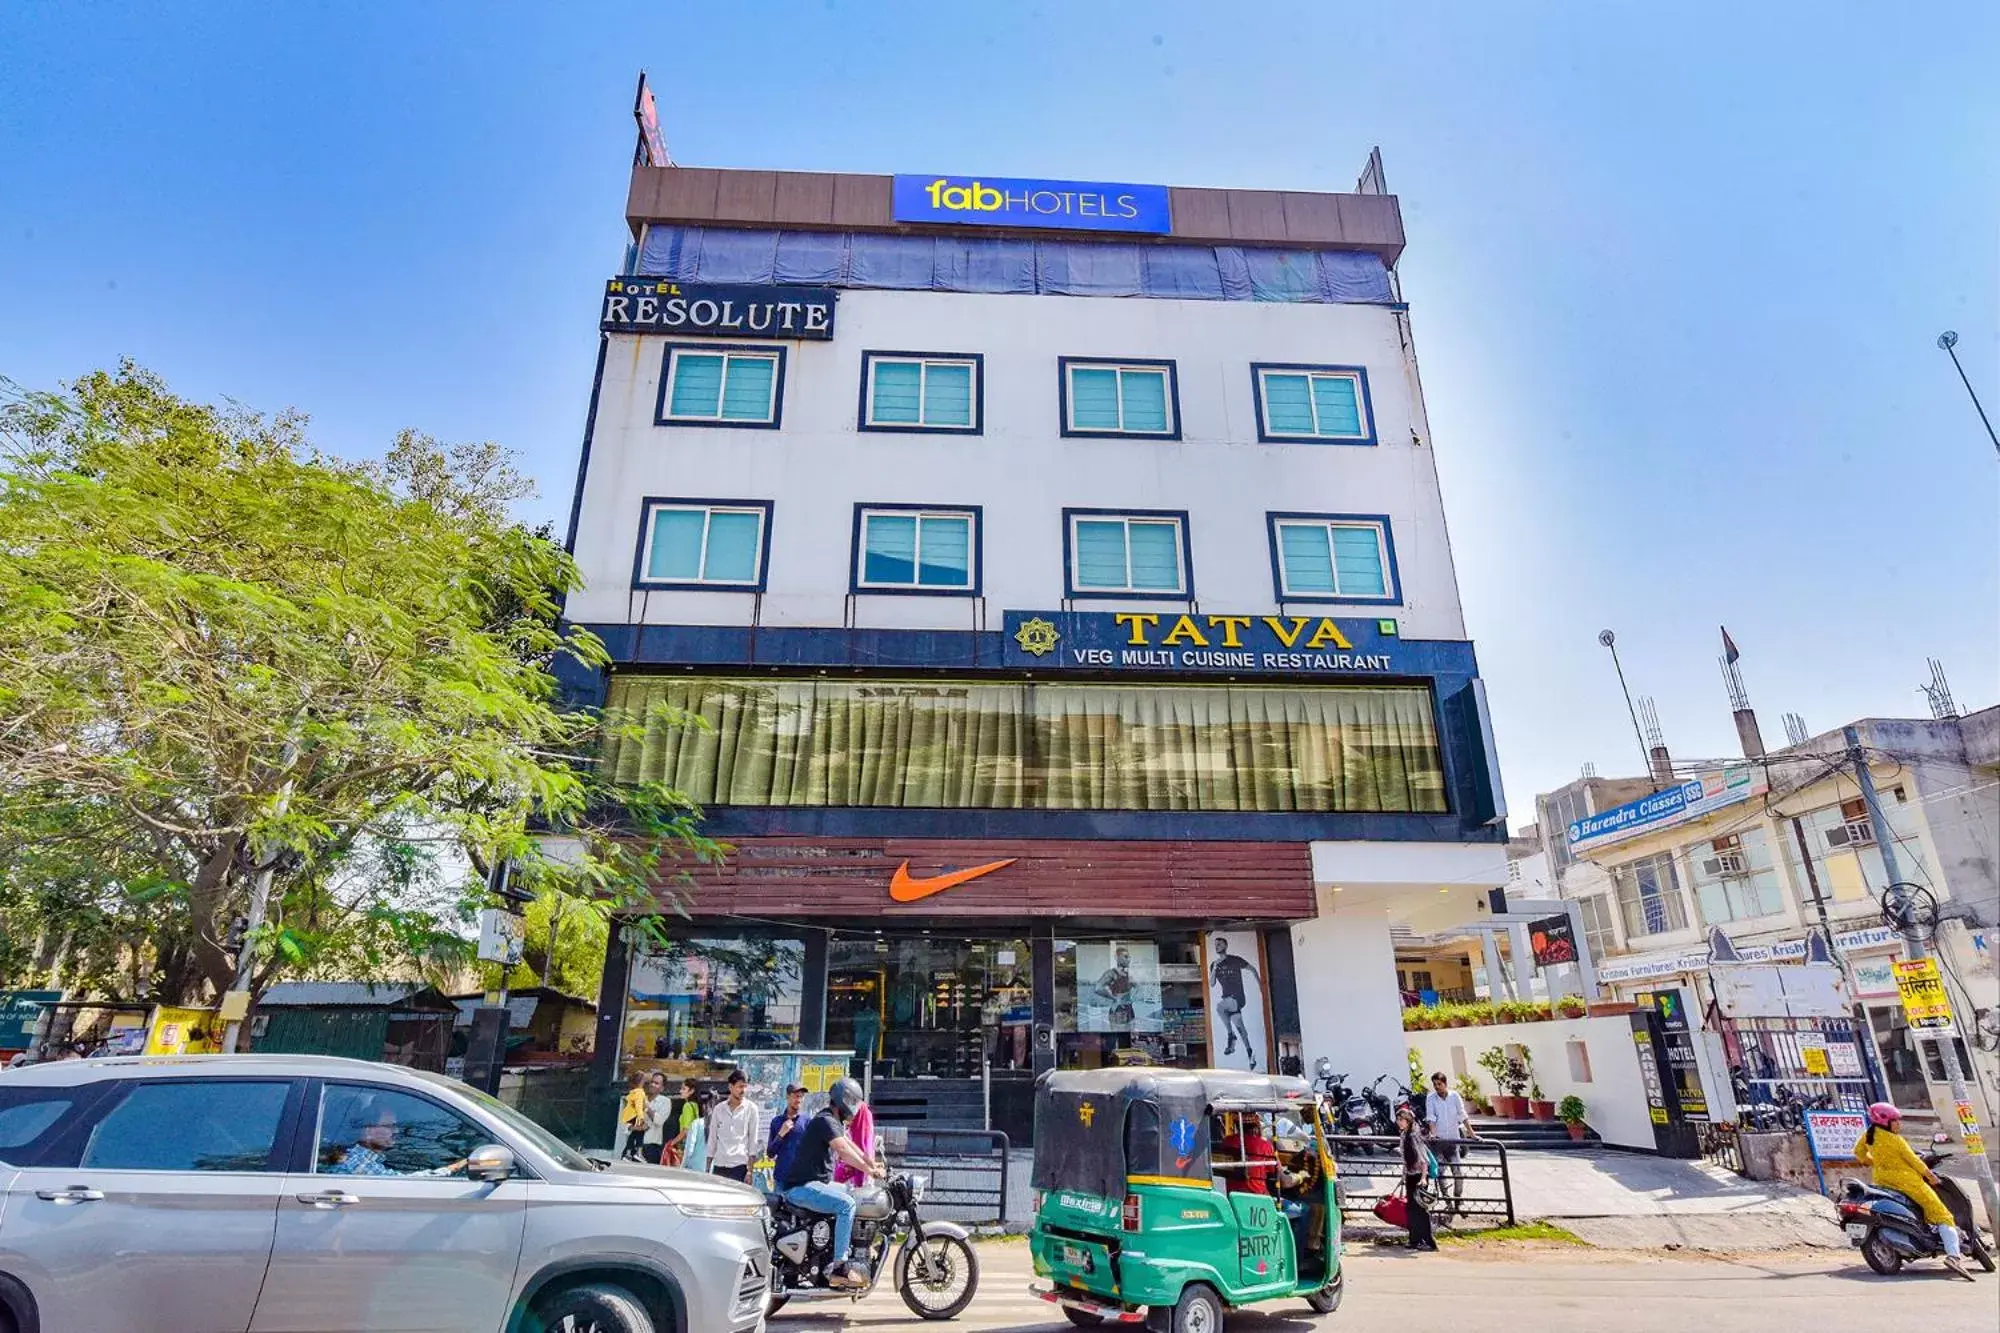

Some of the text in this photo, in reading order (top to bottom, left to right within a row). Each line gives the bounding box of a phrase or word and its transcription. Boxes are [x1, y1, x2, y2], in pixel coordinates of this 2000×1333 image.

[925, 179, 1138, 218] fabHOTELS
[609, 281, 681, 296] HOTEL
[603, 296, 830, 330] RESOLUTE
[1115, 613, 1353, 649] TATVA
[1073, 649, 1391, 670] VEG MULTI CUISINE RESTAURANT
[1581, 808, 1636, 835] Harendra
[1639, 792, 1683, 815] Classes
[1899, 976, 1941, 999] पुलिस
[1667, 1047, 1695, 1060] HOTEL
[1638, 1043, 1663, 1107] PARKING
[1249, 1206, 1267, 1228] NO
[1239, 1235, 1279, 1257] ENTRY
